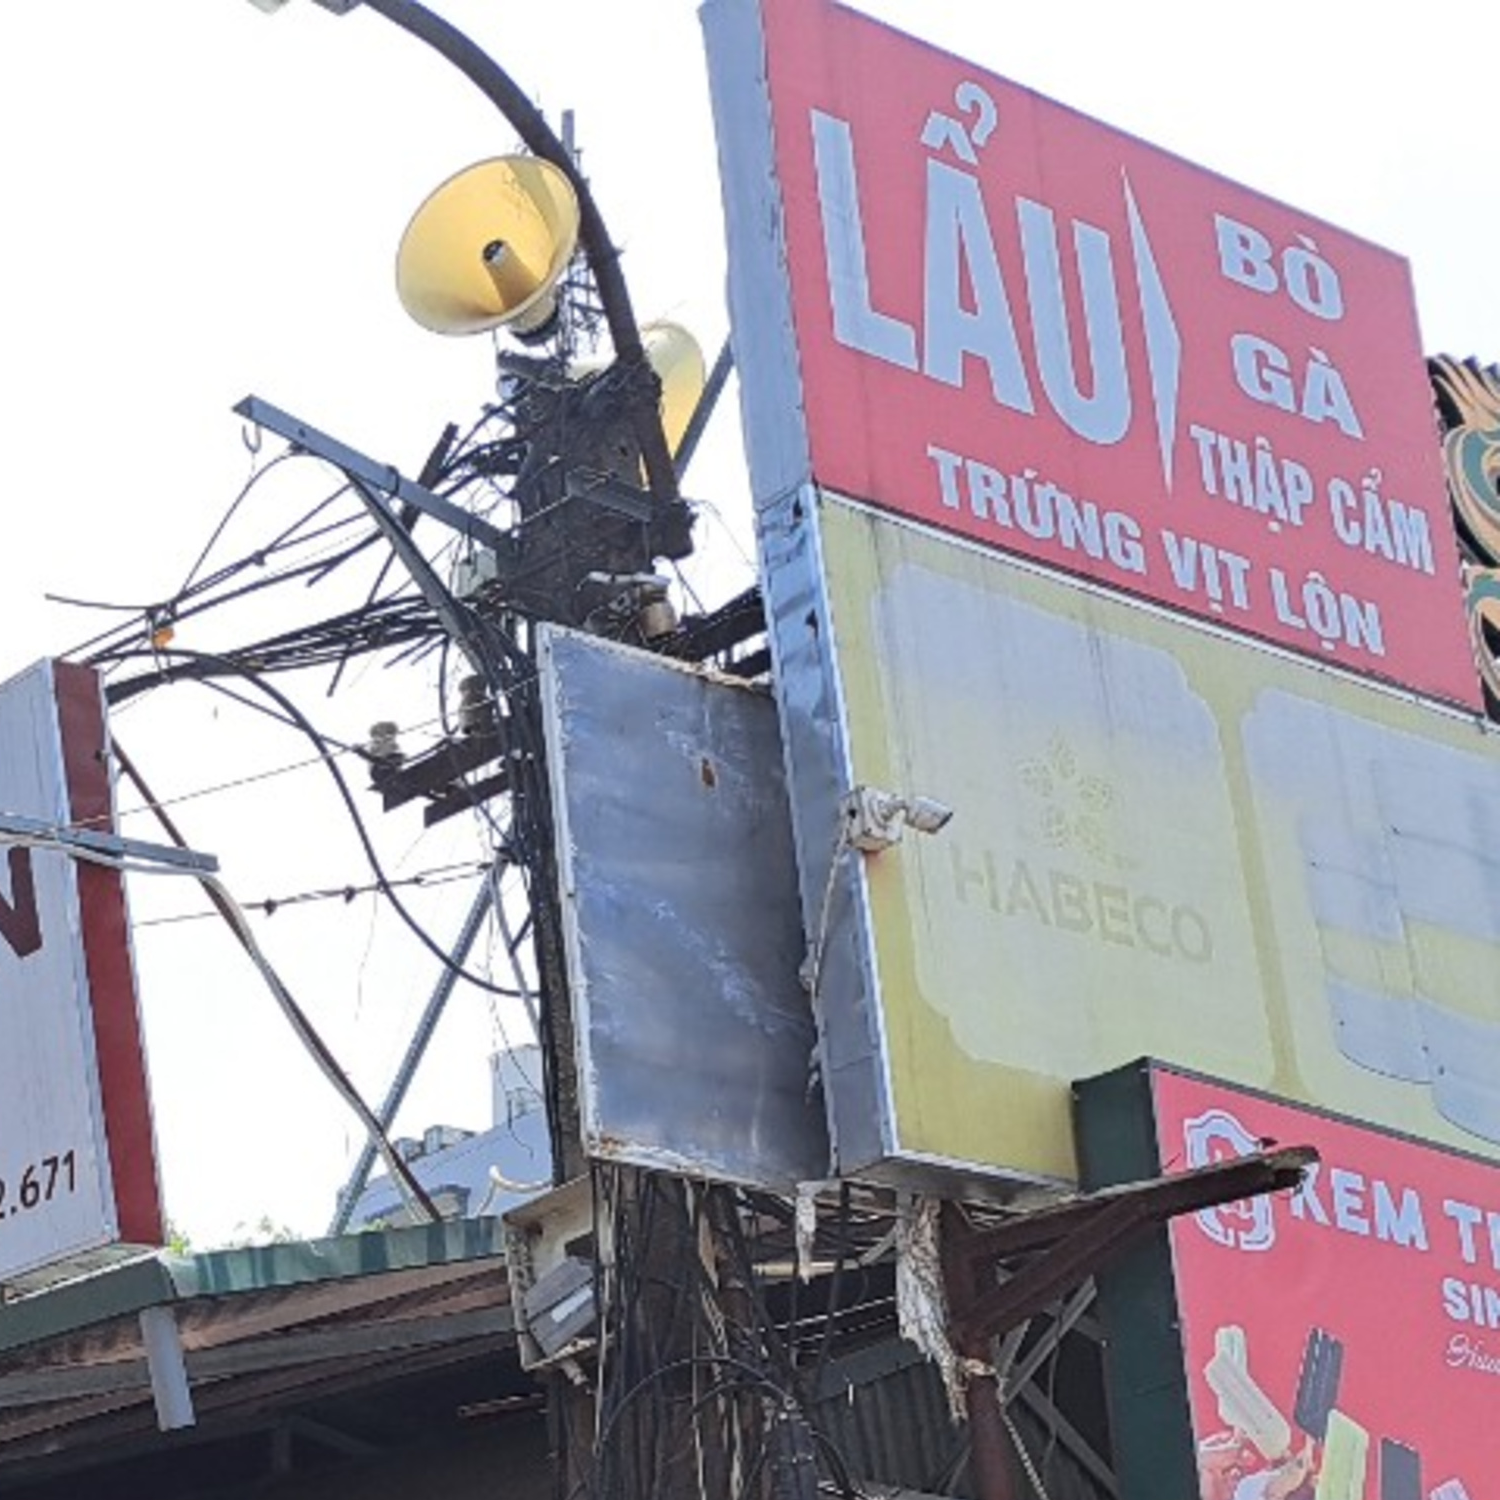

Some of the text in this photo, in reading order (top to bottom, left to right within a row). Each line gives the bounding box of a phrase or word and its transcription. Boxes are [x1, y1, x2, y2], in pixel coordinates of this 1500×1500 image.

[811, 81, 1132, 446] LẨU
[1214, 213, 1344, 321] BÒ
[1230, 332, 1364, 441] GÀ
[1190, 423, 1313, 533] THẬP
[927, 446, 1387, 656] TRỨNG VỊT LỘN
[949, 843, 1215, 963] HABECO
